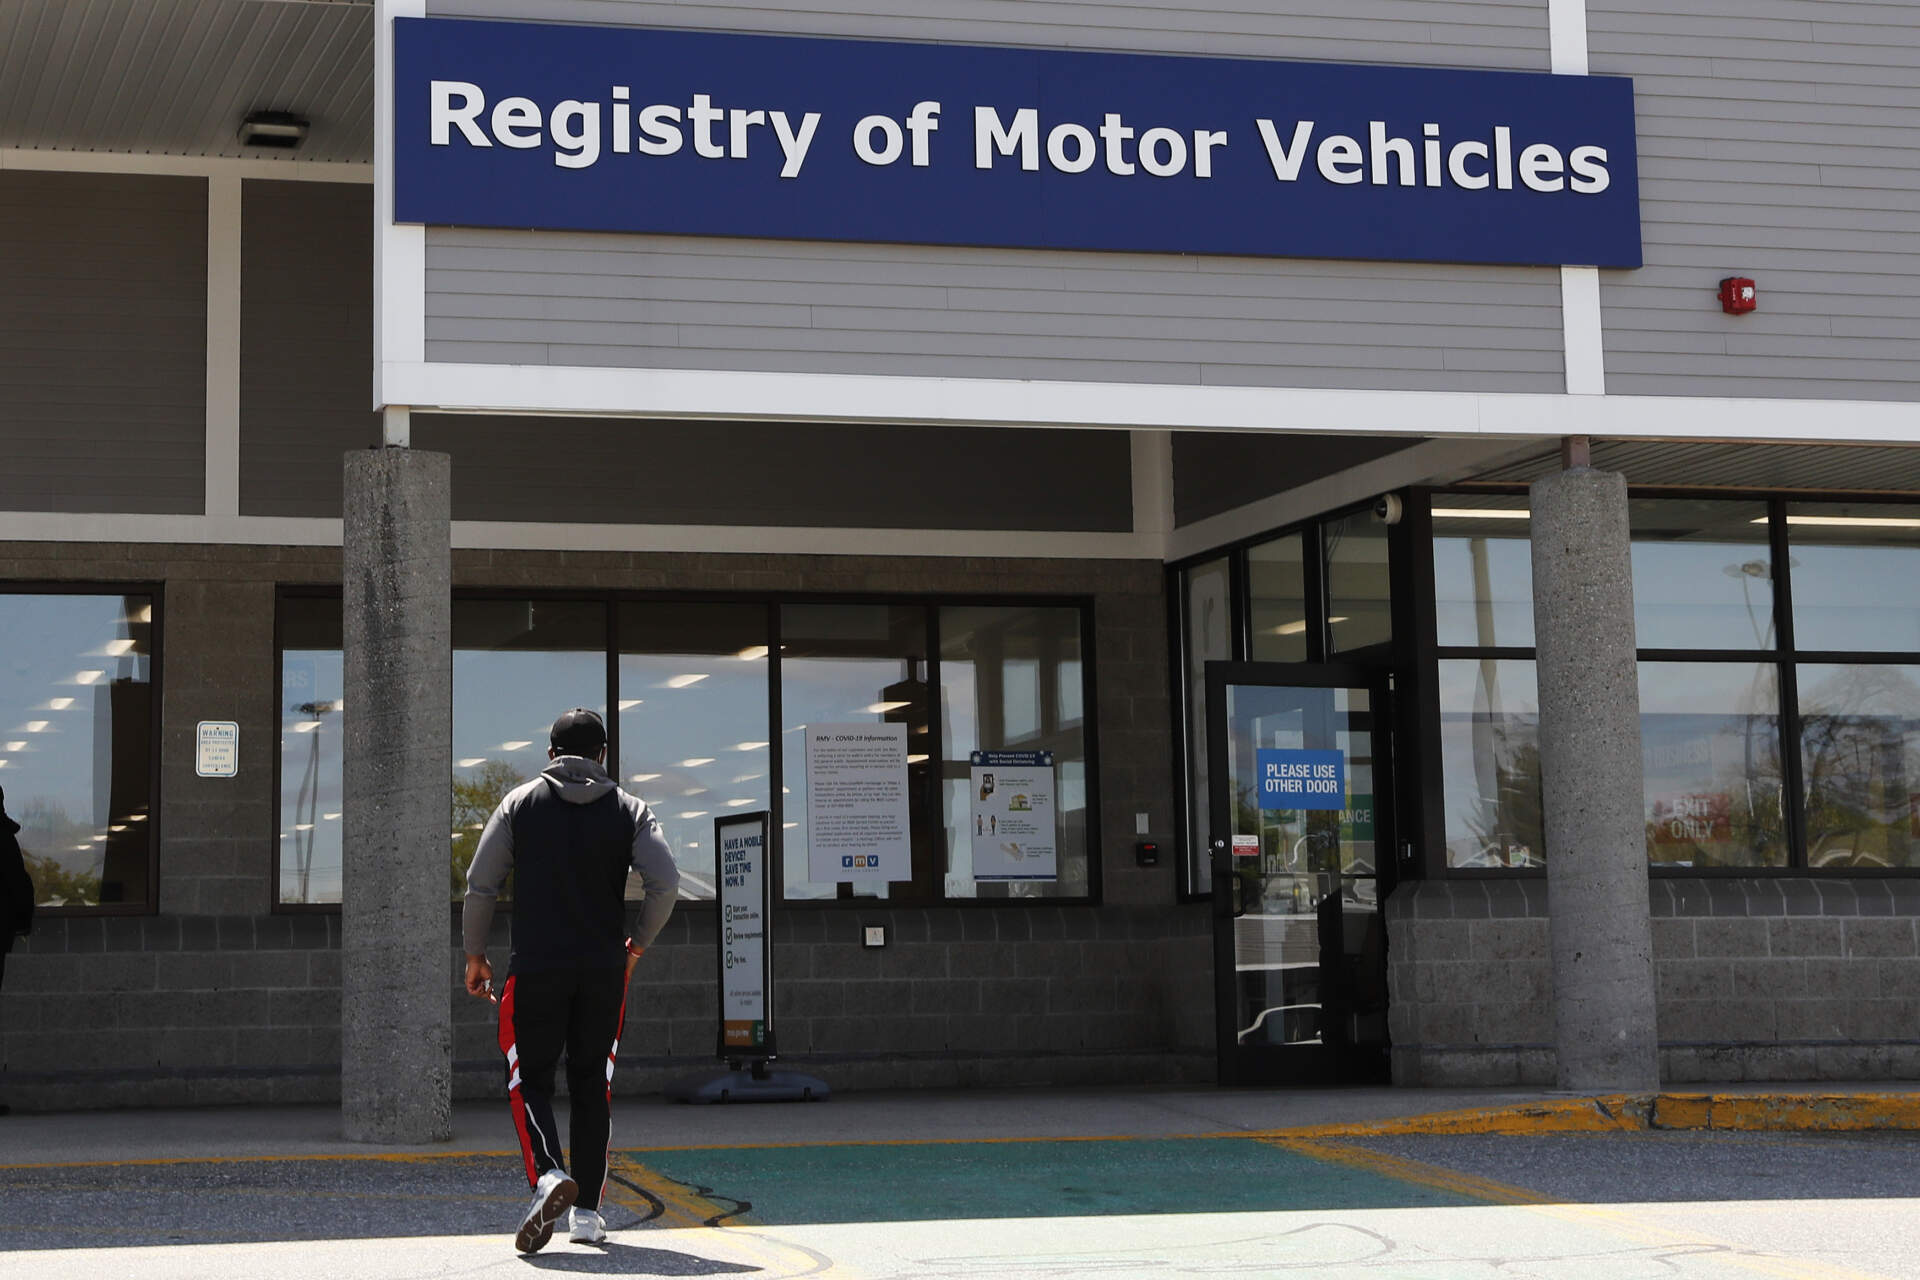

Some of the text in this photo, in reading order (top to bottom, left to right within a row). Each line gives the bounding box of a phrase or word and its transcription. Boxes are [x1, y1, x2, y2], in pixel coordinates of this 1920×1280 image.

[430, 80, 1610, 194] Registry of Motor Vehicles
[202, 729, 233, 737] WARNING
[863, 734, 898, 743] Information
[1266, 763, 1336, 778] PLEASE USE
[1265, 779, 1338, 793] OTHER DOOR
[1672, 798, 1711, 816] EXIT
[1671, 820, 1713, 839] ONLY
[724, 838, 739, 849] HAVE
[739, 838, 744, 848] A
[724, 850, 746, 862] DEVICE?
[725, 862, 751, 874] SAVE TIME
